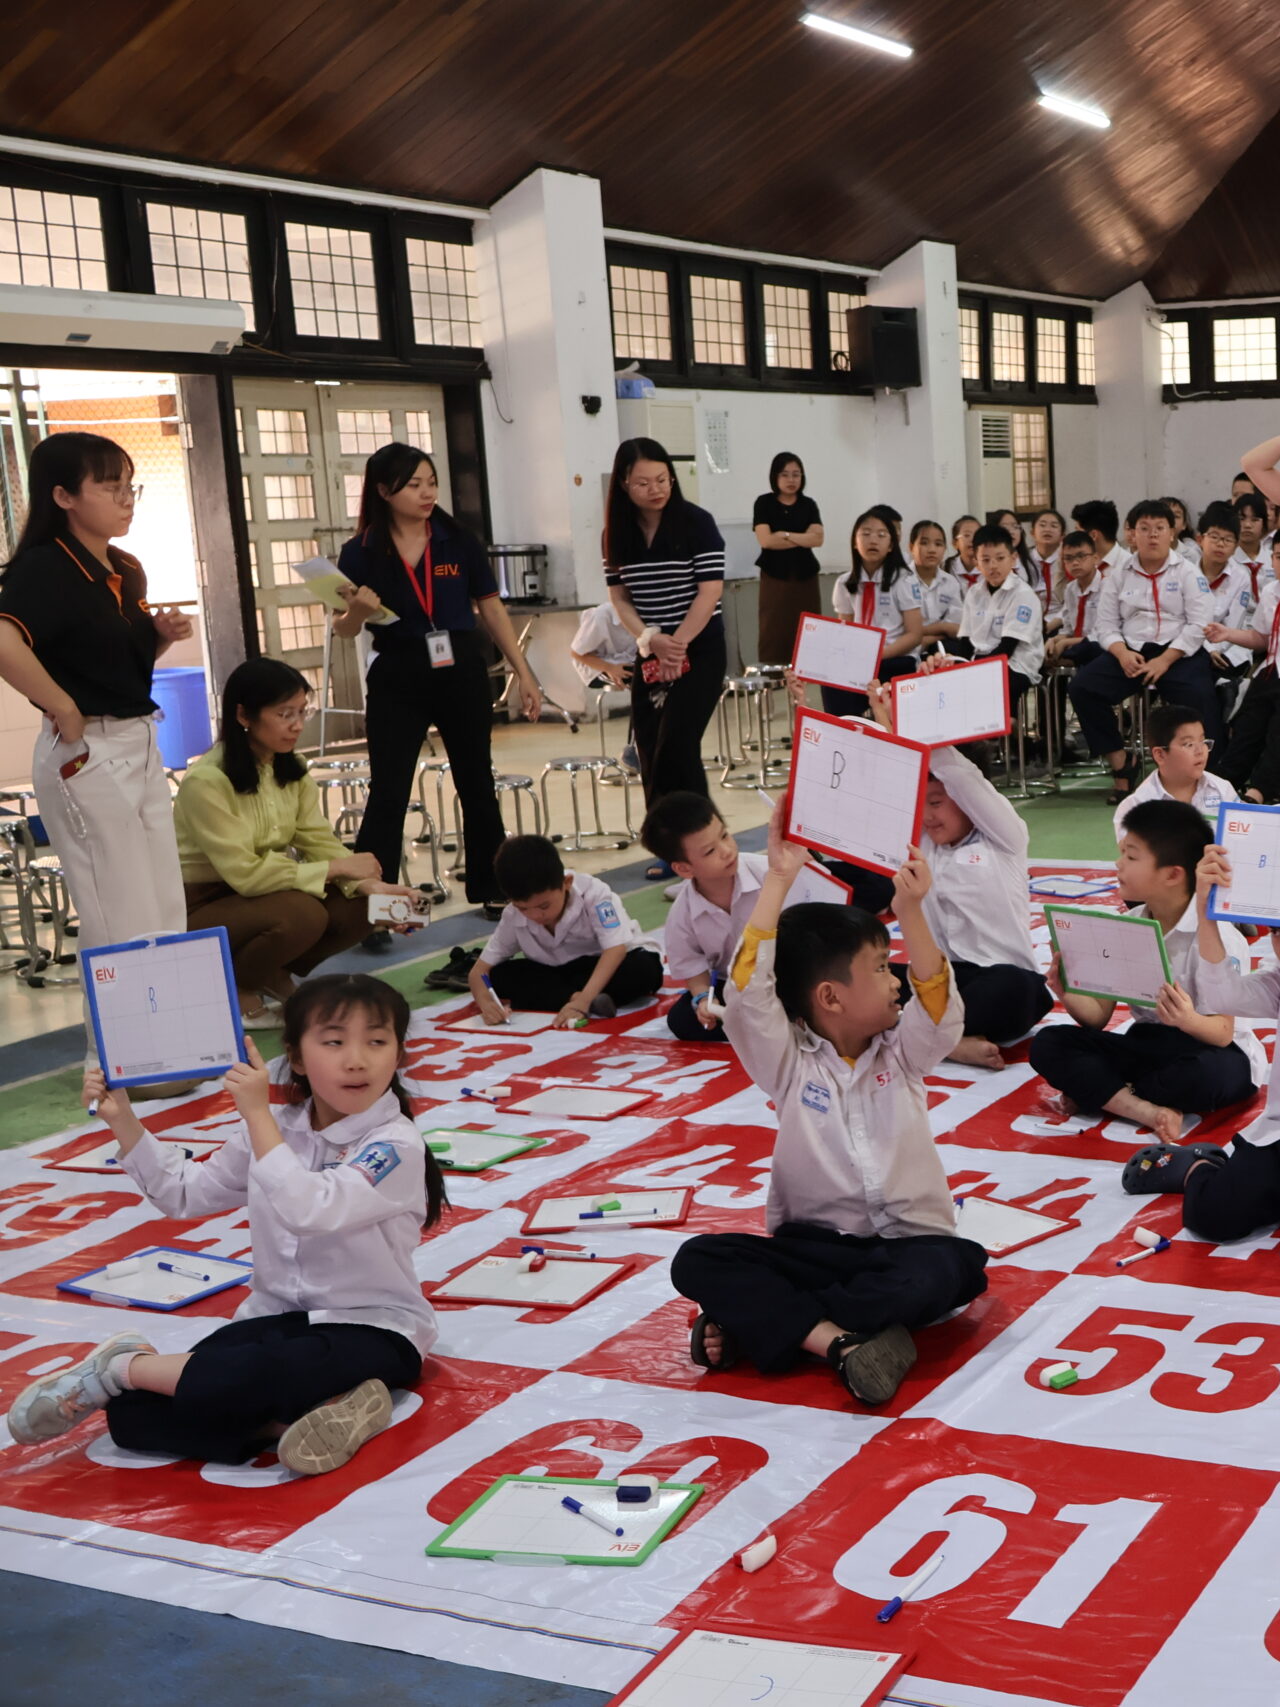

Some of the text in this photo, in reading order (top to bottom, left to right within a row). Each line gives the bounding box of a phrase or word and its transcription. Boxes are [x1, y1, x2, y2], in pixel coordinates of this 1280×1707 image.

[830, 750, 846, 790] B
[1258, 854, 1267, 869] B
[832, 1472, 1164, 1629] 61
